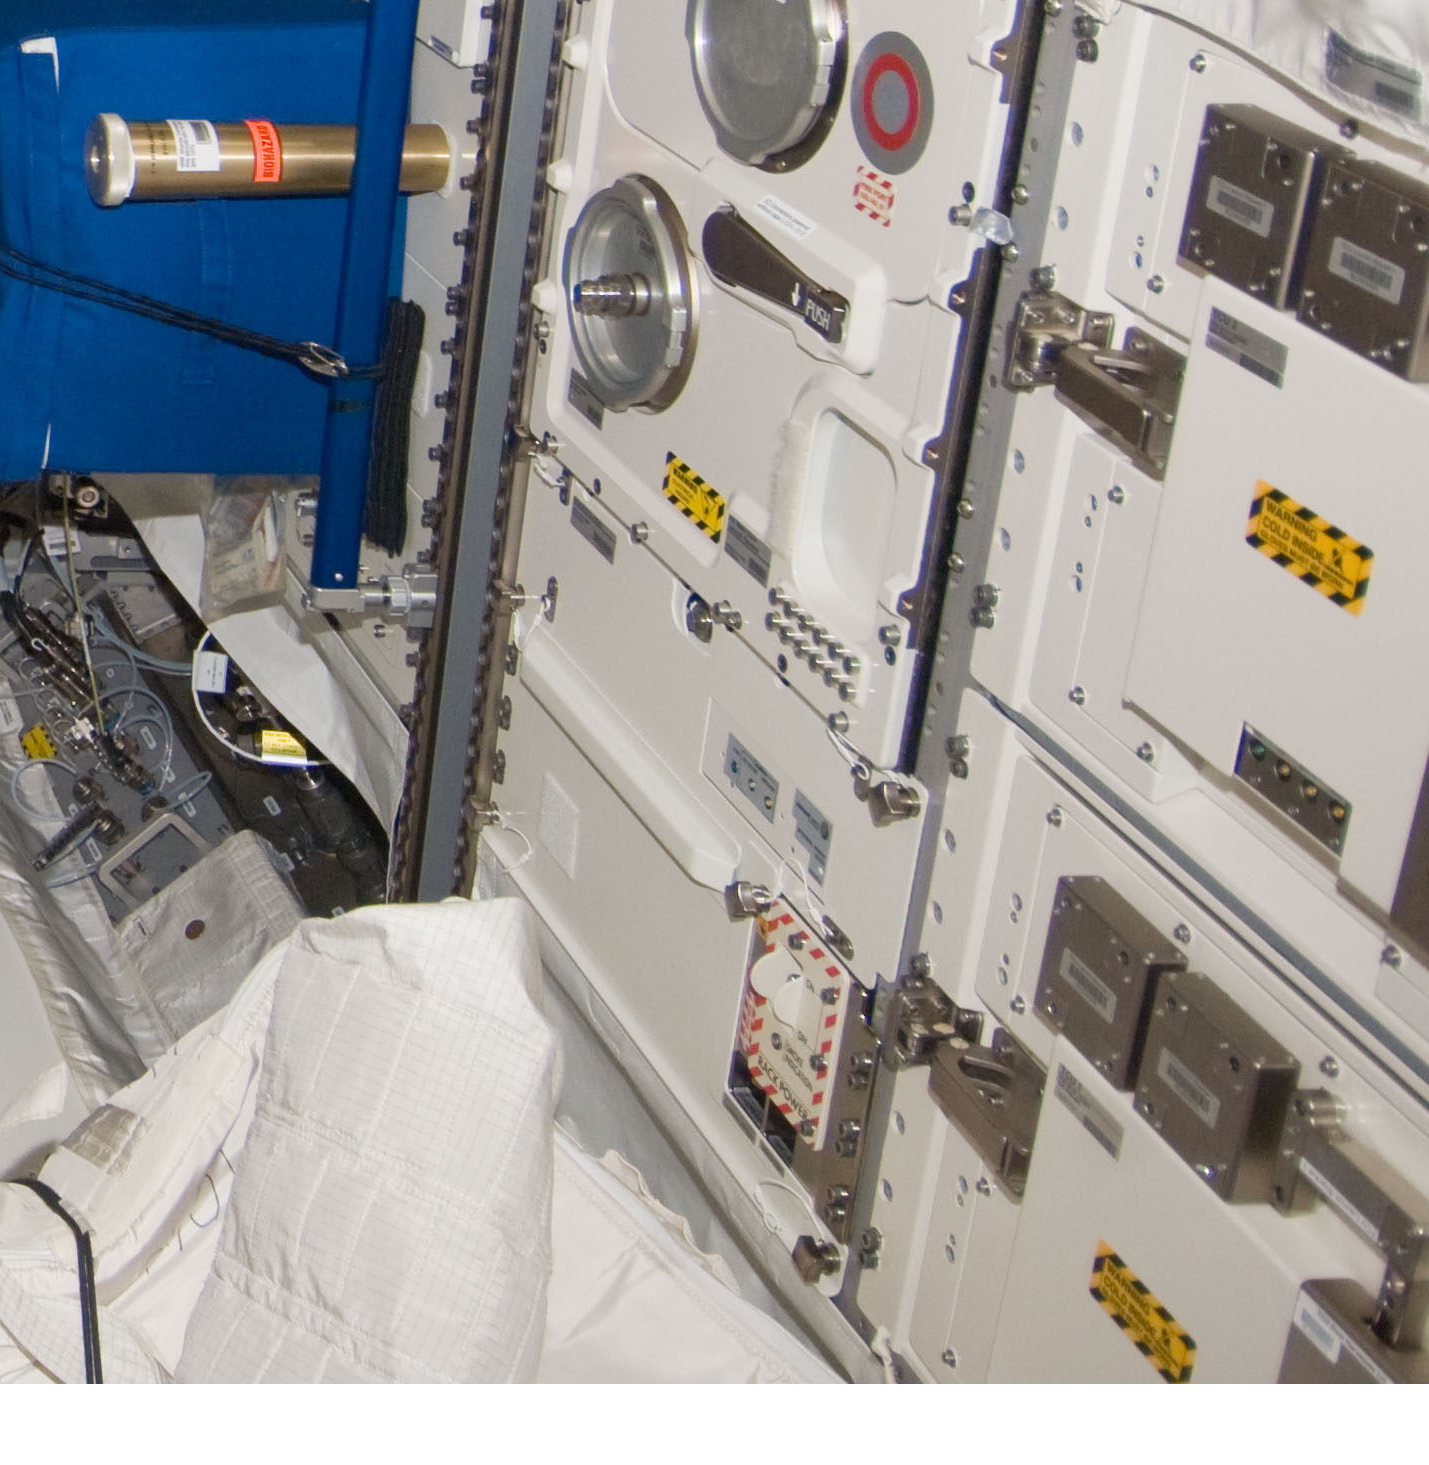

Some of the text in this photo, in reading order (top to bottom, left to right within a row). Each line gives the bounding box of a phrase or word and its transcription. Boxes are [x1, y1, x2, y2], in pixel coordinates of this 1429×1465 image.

[257, 124, 273, 178] BIOHAZARD
[807, 297, 831, 332] PUSH
[1261, 516, 1324, 560] COLD INSIDE
[1264, 498, 1318, 543] WARNING
[805, 978, 816, 995] ON
[758, 1054, 809, 1120] RACK POWER
[1103, 1274, 1127, 1303] COLD
[1107, 1262, 1150, 1316] WARNING
